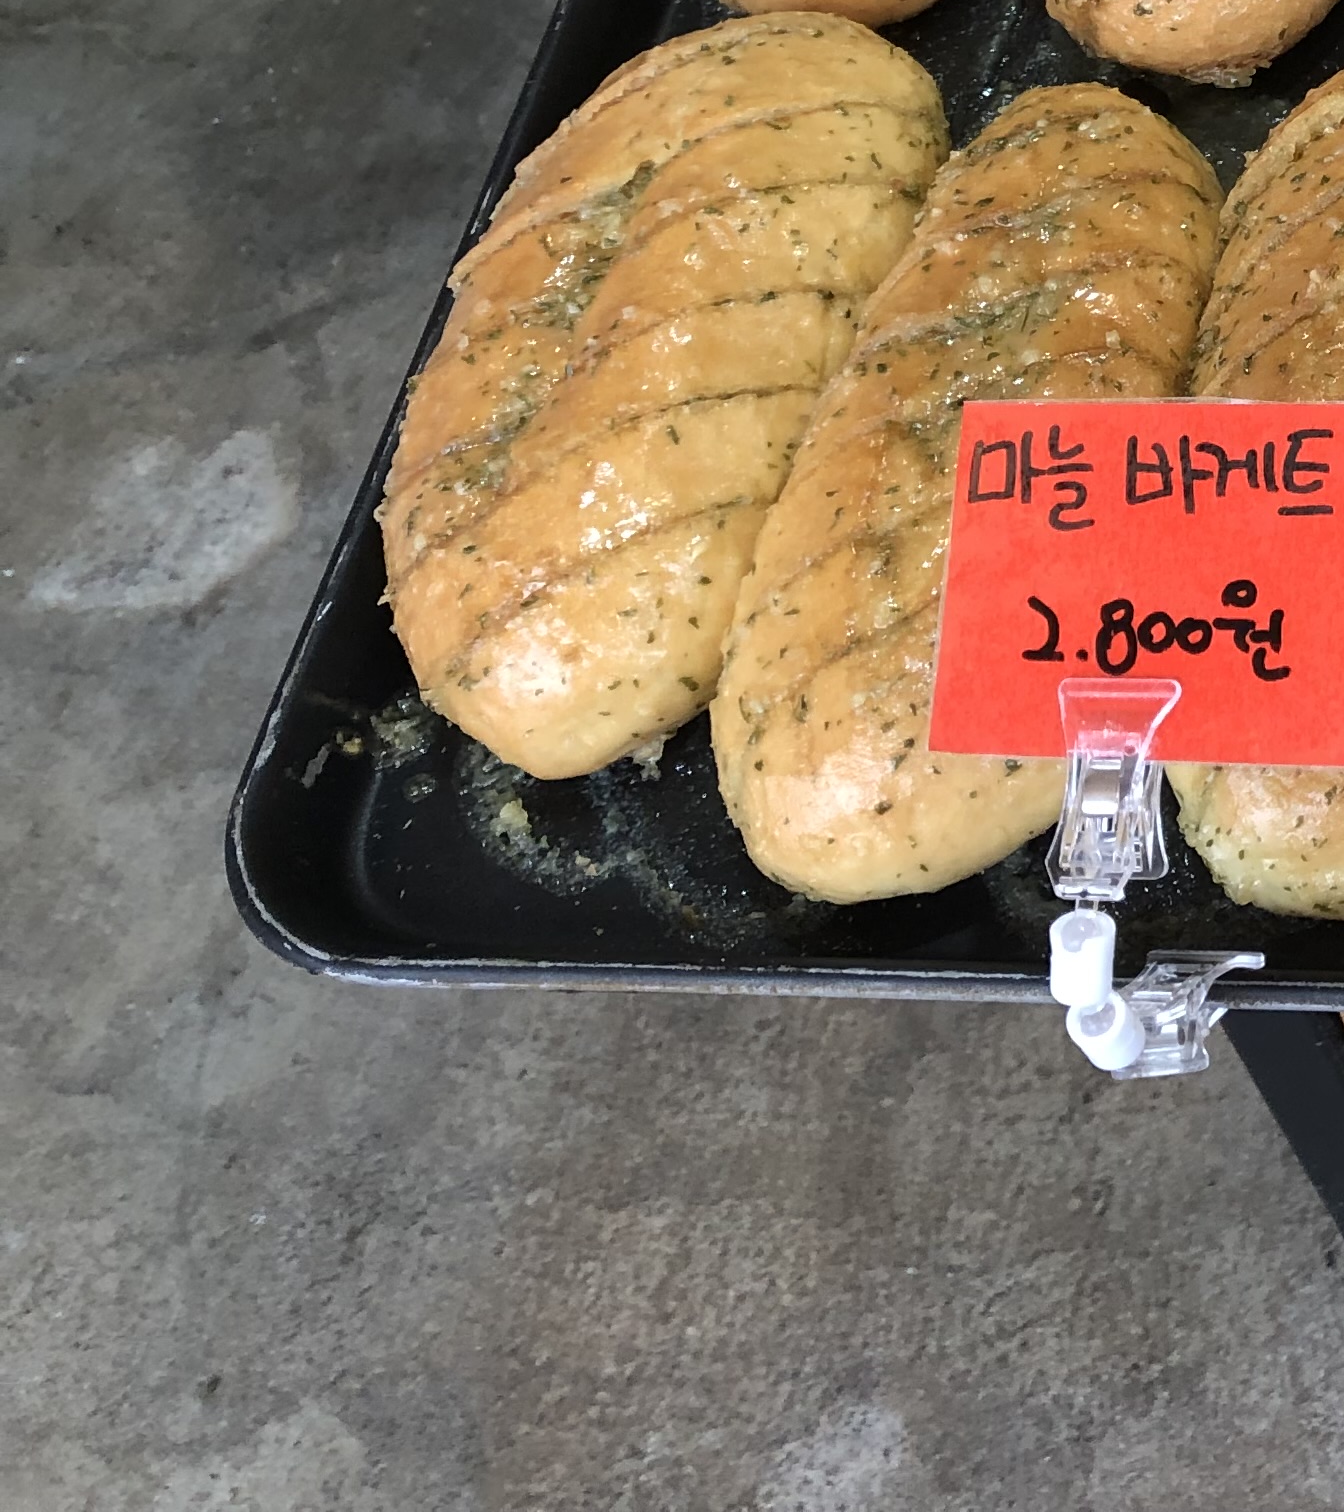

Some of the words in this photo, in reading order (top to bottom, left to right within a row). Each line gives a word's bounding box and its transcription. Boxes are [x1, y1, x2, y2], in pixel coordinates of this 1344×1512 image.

[966, 423, 1096, 532] 마늘
[1124, 428, 1335, 516] 바게트
[1022, 578, 1292, 683] 2.800원
